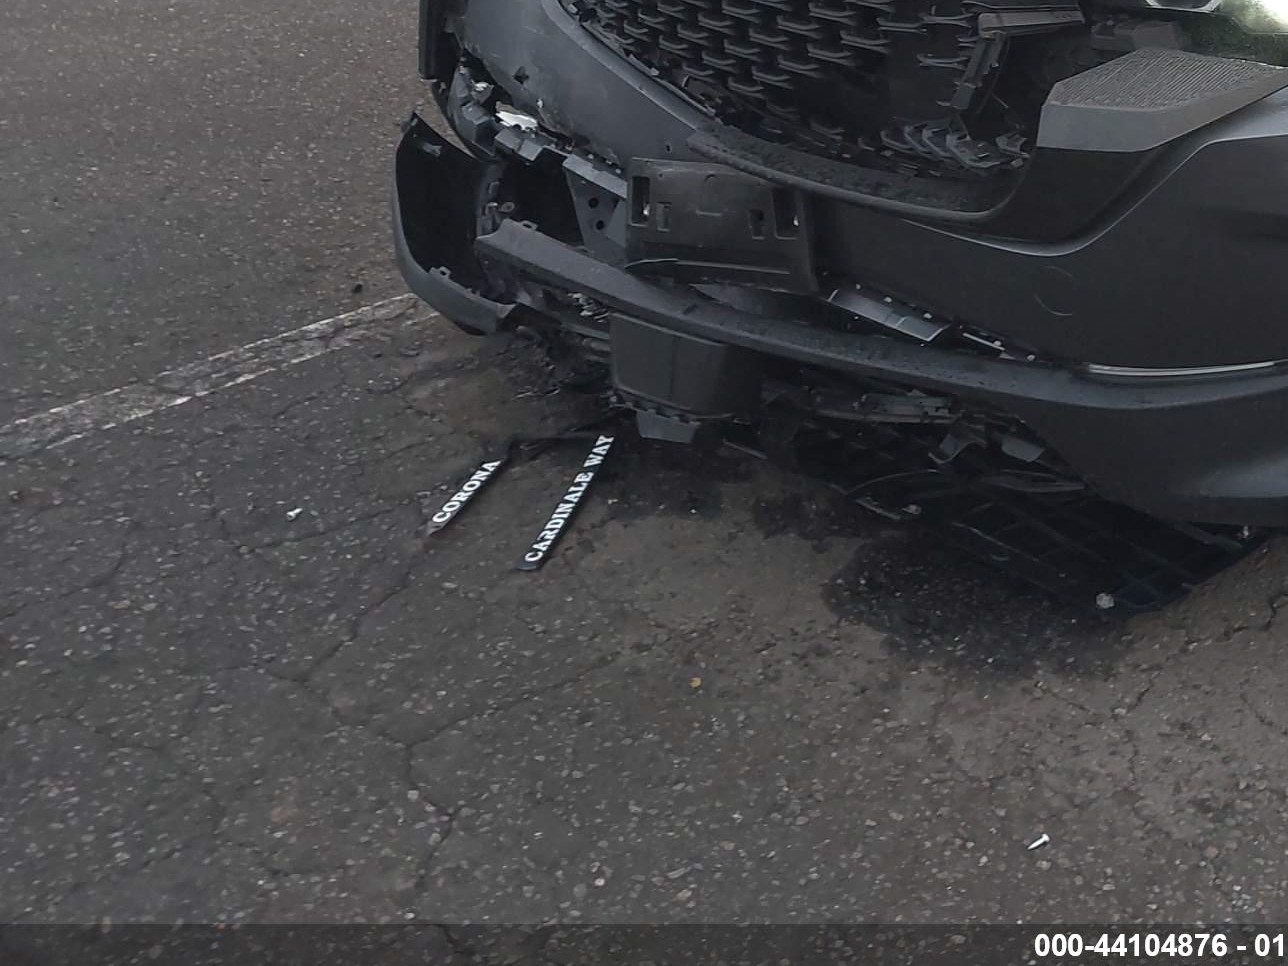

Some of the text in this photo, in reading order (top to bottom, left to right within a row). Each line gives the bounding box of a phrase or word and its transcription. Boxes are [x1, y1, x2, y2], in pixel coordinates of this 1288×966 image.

[432, 460, 501, 523] CORONA
[525, 435, 615, 562] CARDINALE WAY
